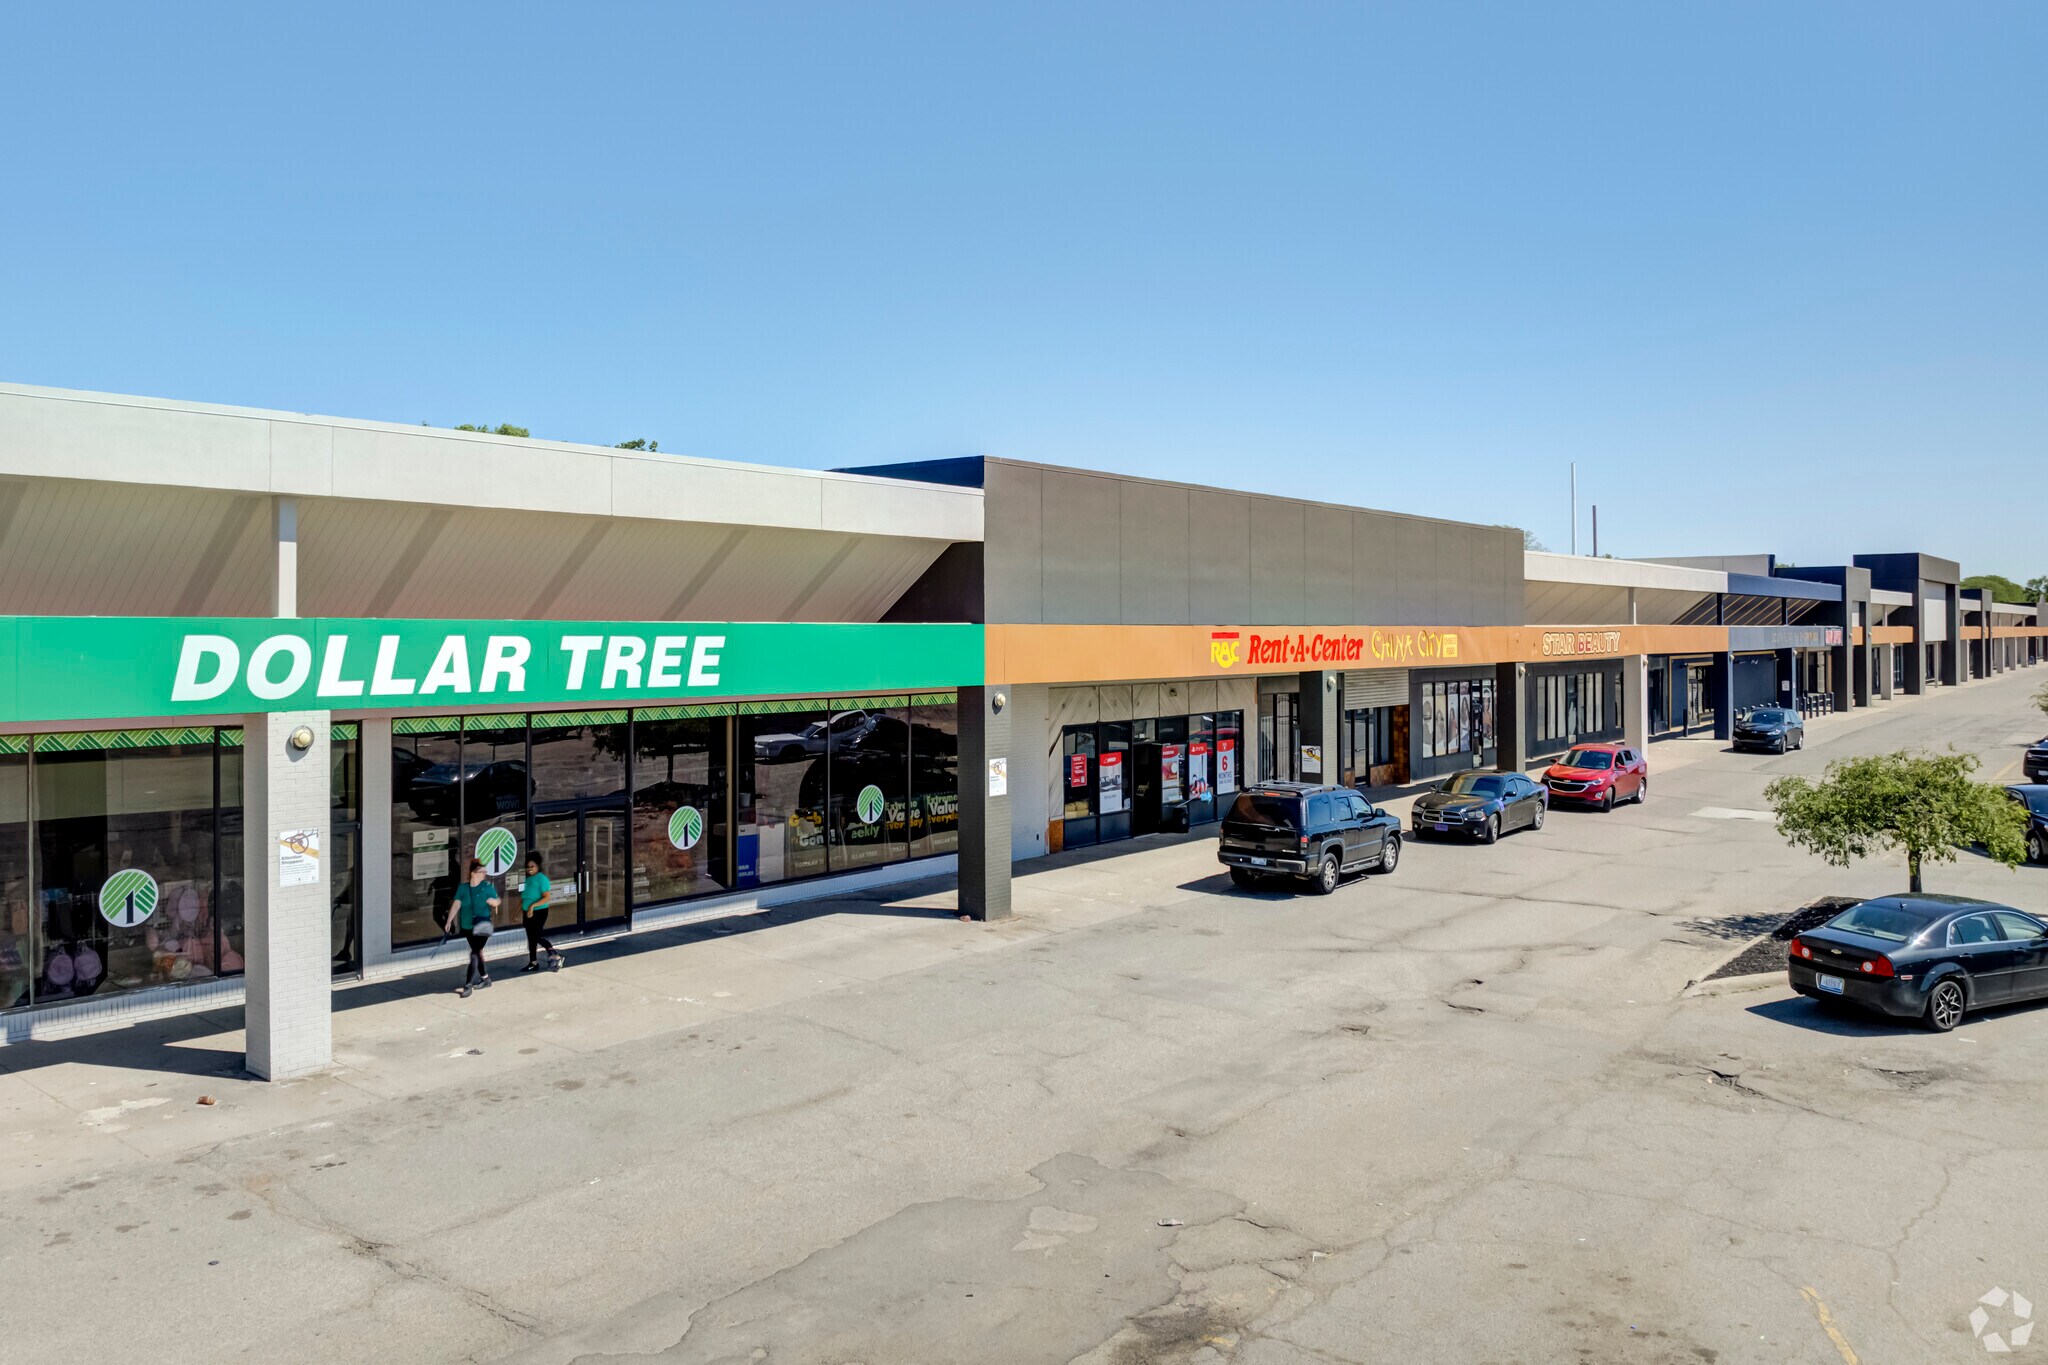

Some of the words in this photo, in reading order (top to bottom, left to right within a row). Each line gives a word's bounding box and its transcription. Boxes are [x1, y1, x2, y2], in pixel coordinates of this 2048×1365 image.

[1211, 641, 1240, 668] RAC
[1417, 629, 1443, 658] CITY
[1542, 632, 1575, 656] STAR
[1577, 631, 1621, 655] BEAUTY
[170, 634, 531, 702] DOLLAR
[558, 634, 726, 691] TREE
[1222, 755, 1228, 771] 6
